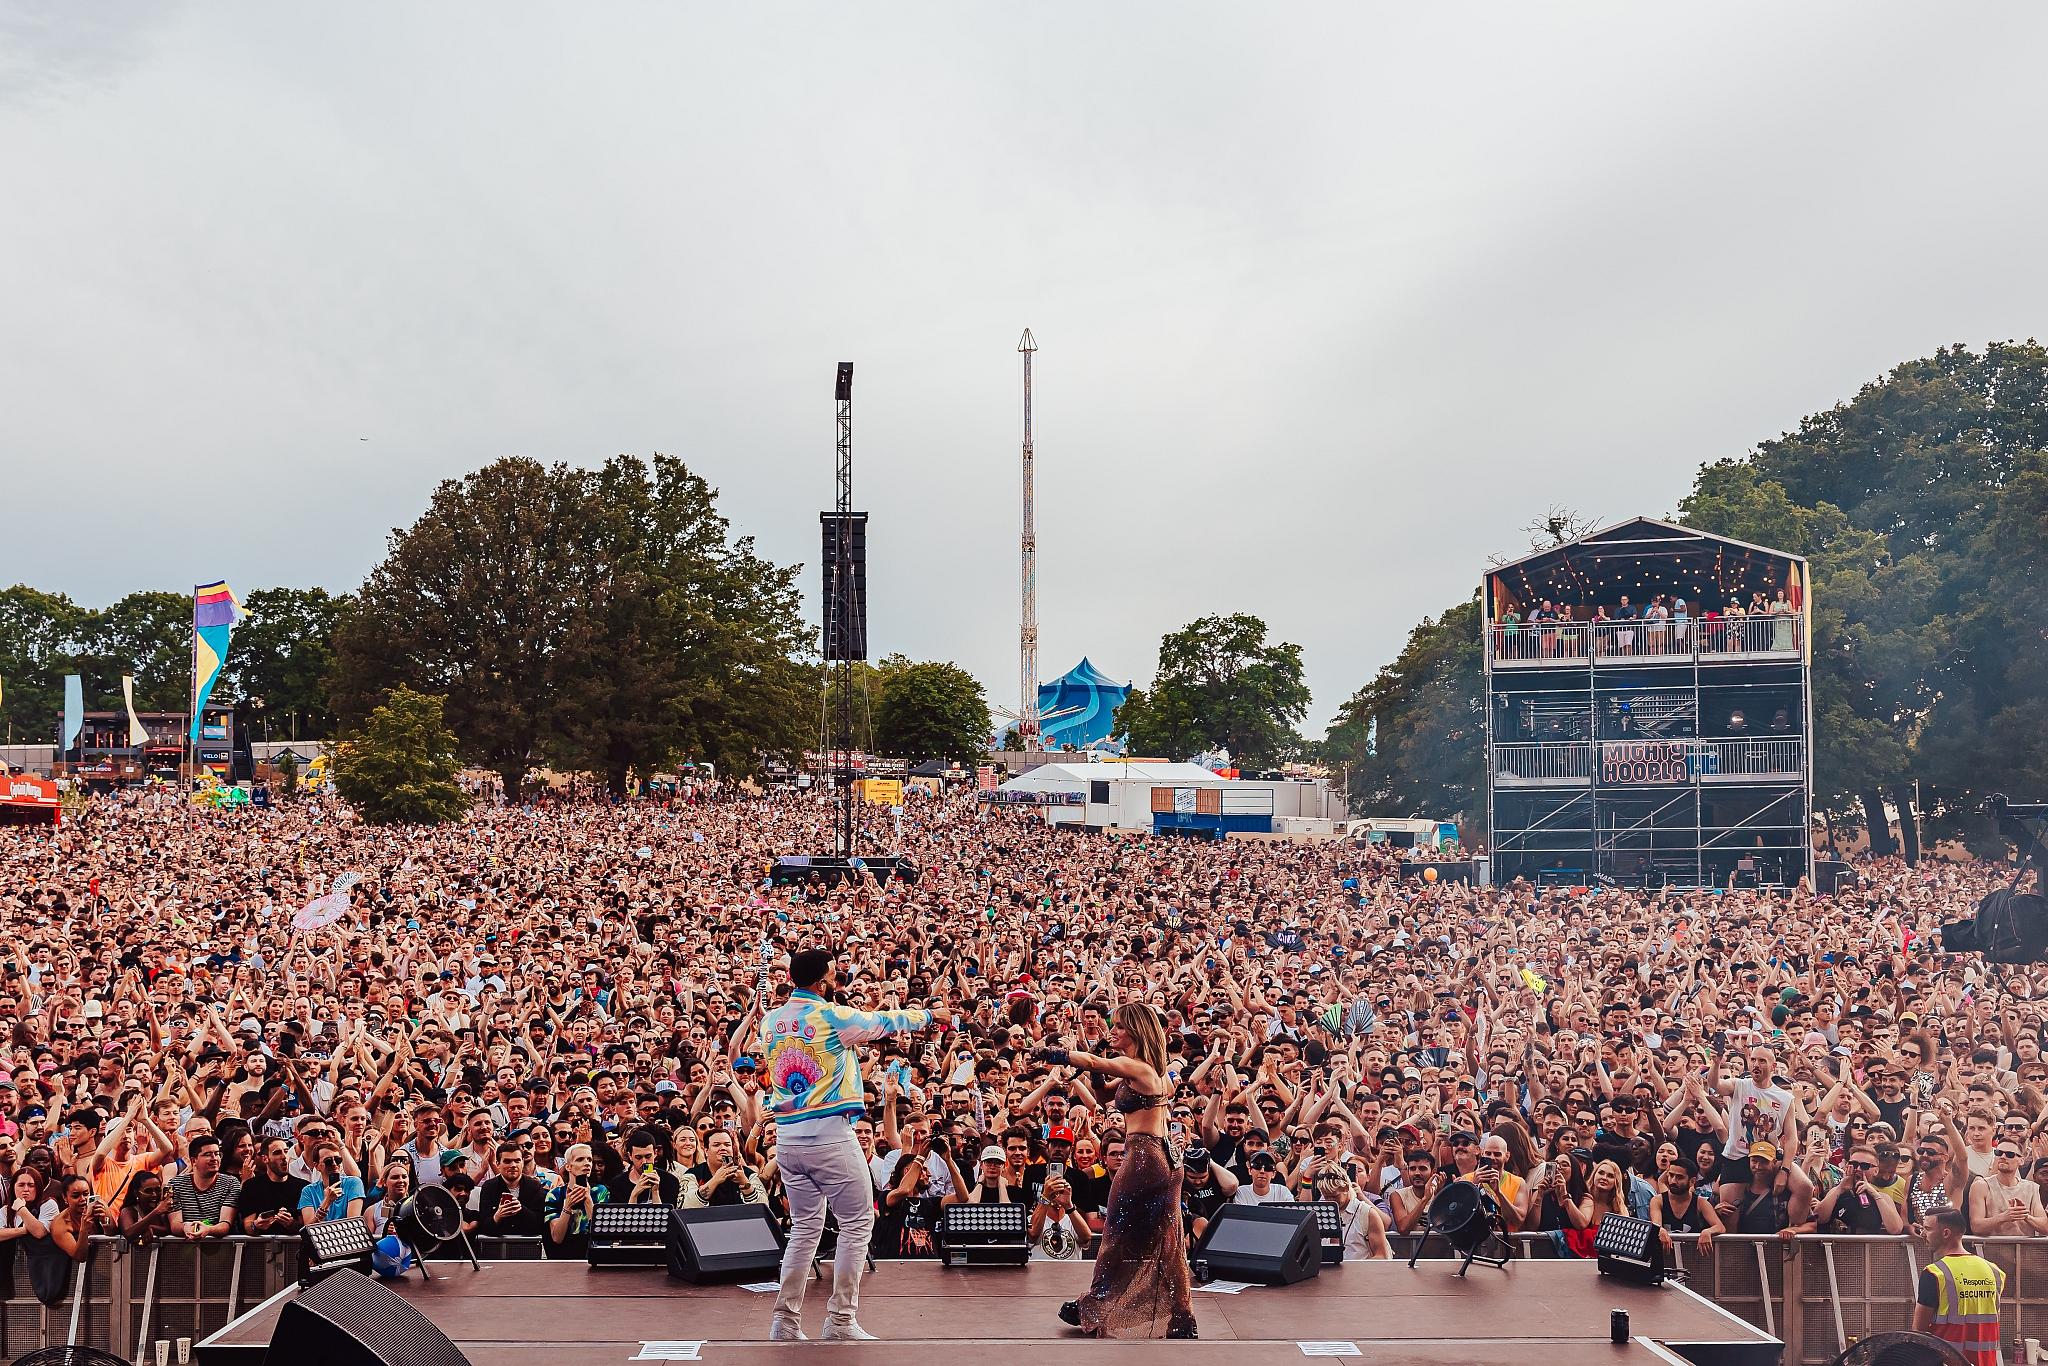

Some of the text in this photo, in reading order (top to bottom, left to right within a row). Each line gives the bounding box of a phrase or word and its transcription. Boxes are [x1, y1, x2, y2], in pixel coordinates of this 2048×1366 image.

[1603, 742, 1686, 762] MIGHTY
[1603, 761, 1687, 782] HOOPLA
[1959, 1290, 1995, 1299] SECURITY
